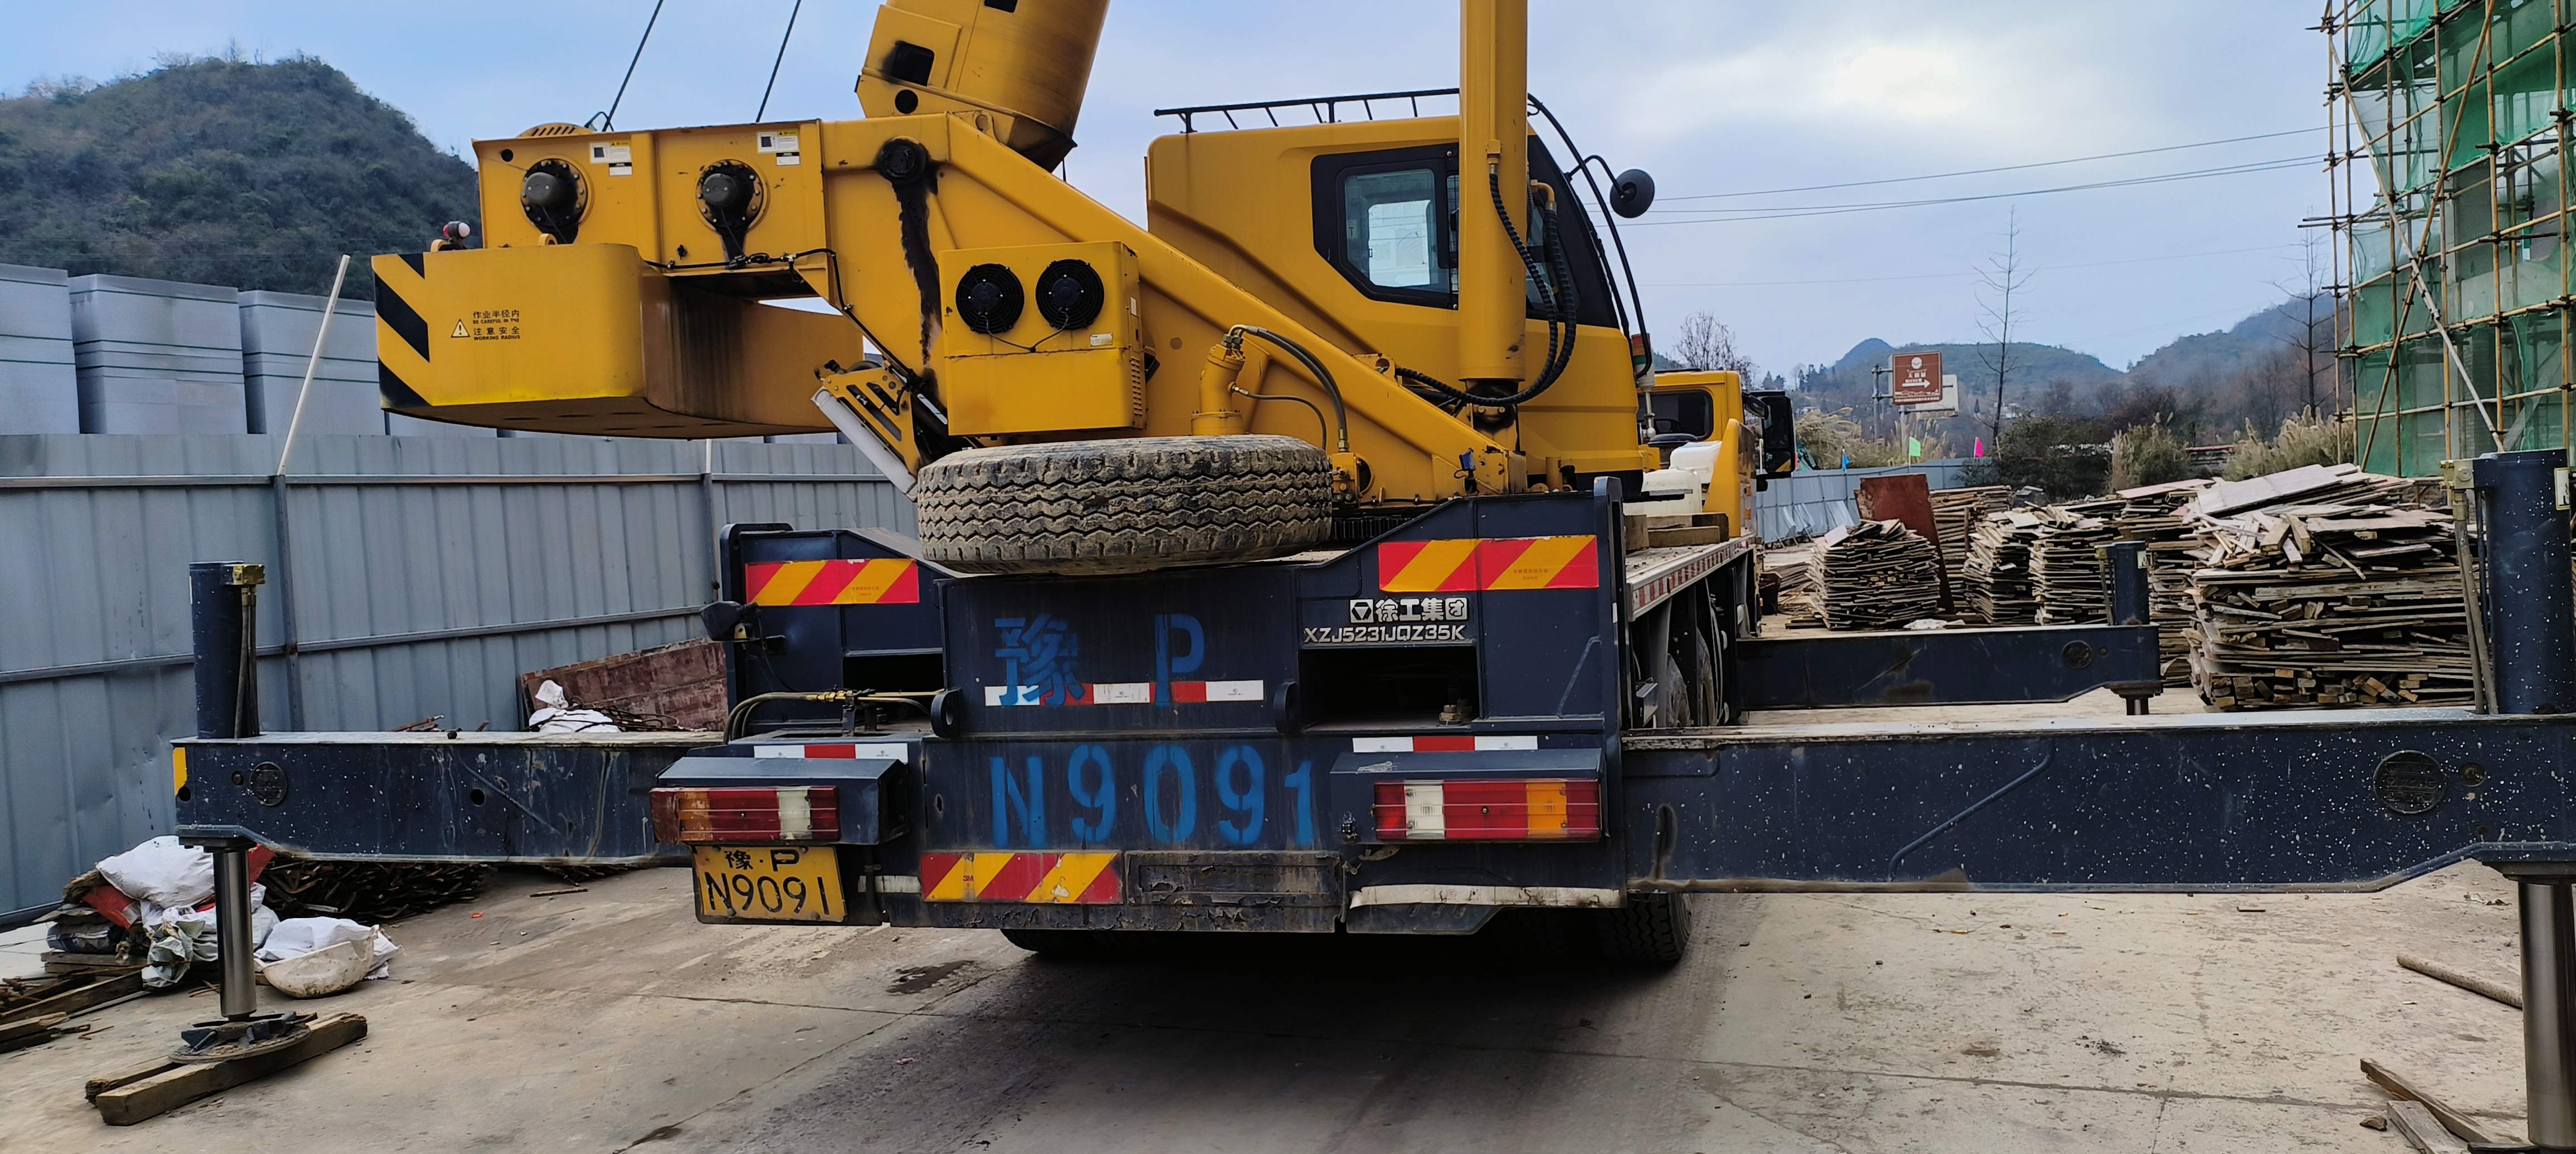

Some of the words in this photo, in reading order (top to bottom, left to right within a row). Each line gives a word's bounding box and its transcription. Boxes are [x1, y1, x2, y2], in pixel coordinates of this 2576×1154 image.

[473, 310, 519, 319] 作业半径内
[474, 326, 520, 335] 注意安全
[1374, 597, 1468, 623] 徐工集团
[1304, 624, 1466, 643] XZJ5231JQZ35K
[995, 613, 1086, 706] 豫
[1155, 613, 1205, 708] P
[990, 744, 1313, 849] N9091
[704, 871, 830, 916] N9091
